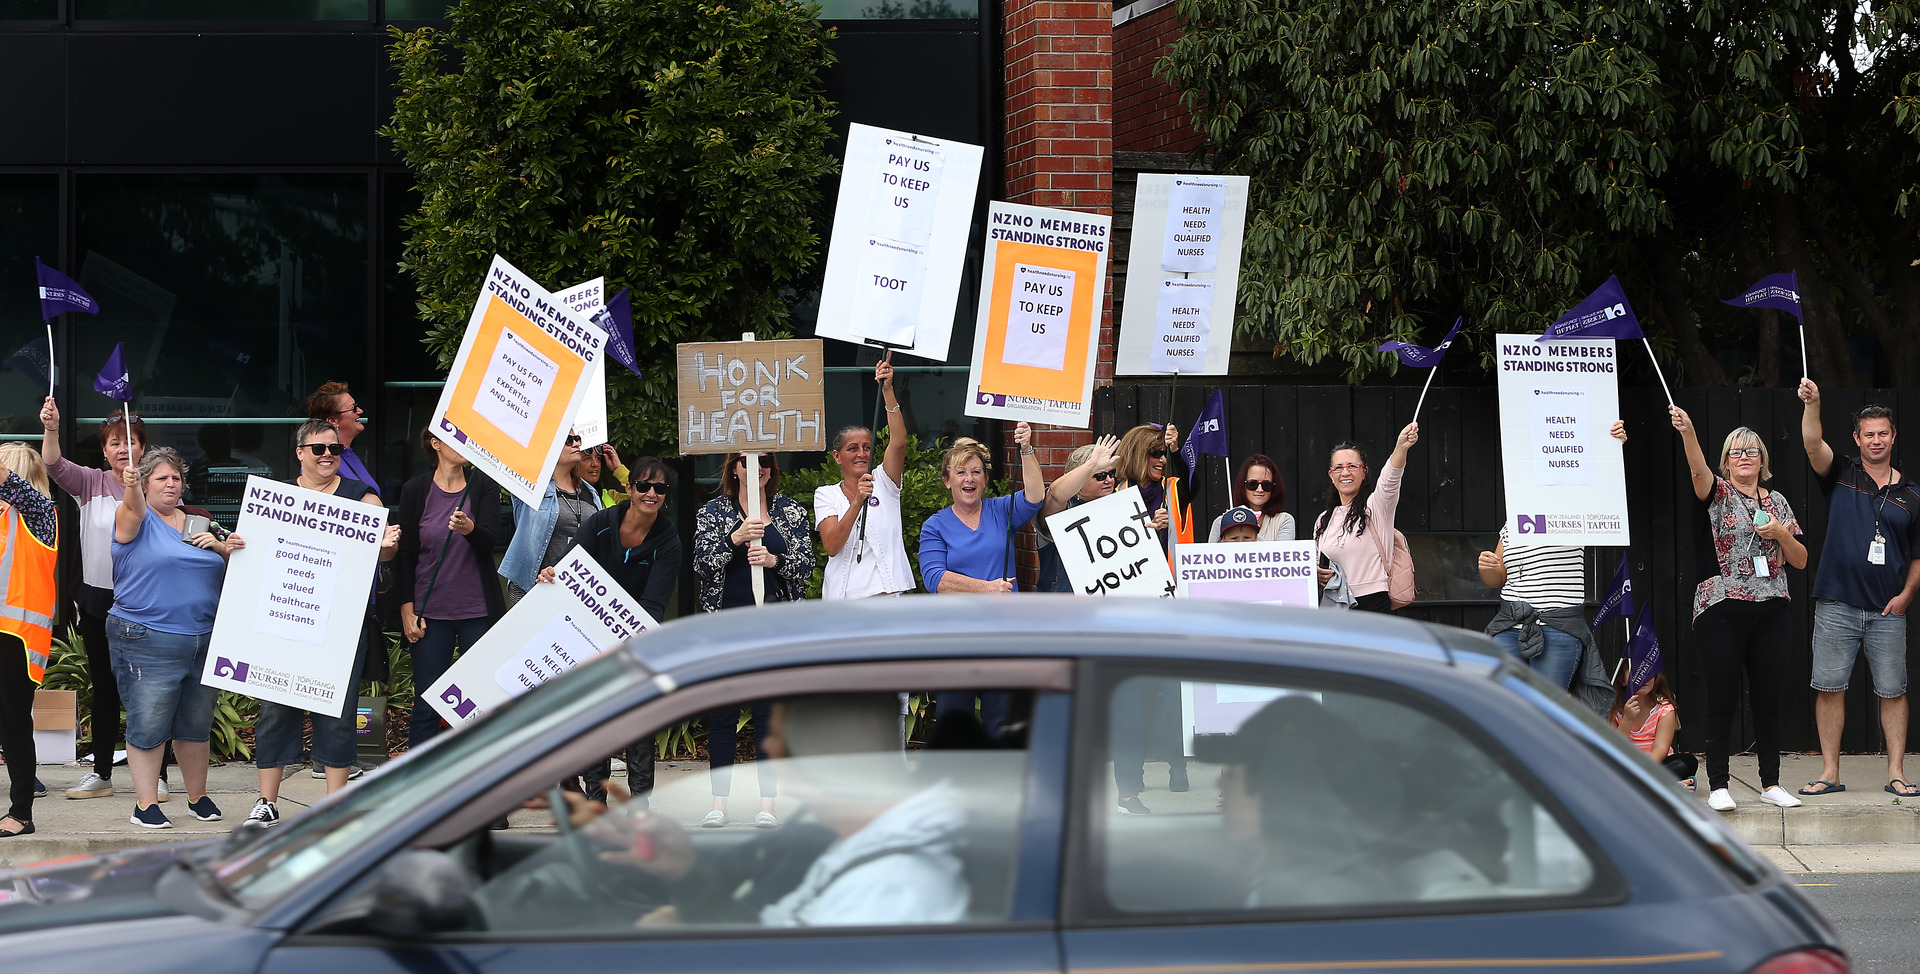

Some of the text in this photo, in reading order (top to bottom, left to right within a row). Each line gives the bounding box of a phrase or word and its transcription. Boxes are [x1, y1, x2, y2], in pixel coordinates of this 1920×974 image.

[889, 154, 930, 172] PAY US
[883, 173, 930, 191] TO KEEP
[894, 196, 909, 208] US
[1183, 206, 1210, 214] HEALTH
[993, 212, 1105, 236] NZNO MEMBERS
[991, 228, 1103, 252] STANDING STRONG
[1174, 234, 1211, 242] QUALIFIED
[1178, 248, 1204, 256] NURSES
[873, 275, 907, 291] TOOT
[1024, 281, 1063, 296] PAY US
[494, 267, 530, 299] NZNO
[535, 298, 599, 349] MEMBERS
[571, 298, 599, 314] ONG
[1019, 301, 1063, 317] TO KEEP
[1172, 307, 1200, 315] HEALTH
[488, 281, 546, 328] STANDING
[546, 323, 594, 362] STRONG
[1031, 323, 1046, 334] US
[1173, 321, 1195, 329] NEEDS
[1163, 335, 1200, 343] QUALIFIED
[1503, 345, 1613, 358] NZNO MEMBERS
[502, 353, 543, 386] PAY US FOR
[694, 351, 810, 392] HONK
[1504, 361, 1614, 373] STANDING STRONG
[510, 374, 526, 389] OUR
[496, 377, 532, 407] EXPERTISE
[721, 383, 782, 410] FOR
[490, 388, 529, 420] AND SKILLS
[1007, 395, 1043, 405] NURSES
[1007, 403, 1042, 411] ORGANISATION
[1048, 400, 1081, 410] TAPUHI
[687, 405, 820, 445] HEALTH
[1546, 416, 1576, 424] HEALTH
[1542, 446, 1584, 454] QUALIFIED
[1549, 460, 1579, 468] NURSES
[250, 487, 380, 528] NZNO MEMBERS
[246, 503, 376, 544] STANDING STRONG
[1547, 521, 1582, 529] NURSES
[1587, 521, 1621, 529] TAPUHI
[1064, 501, 1151, 564] Toot
[275, 549, 332, 568] good health
[1181, 550, 1311, 565] NZNO MEMBERS
[287, 567, 315, 580] needs
[570, 559, 607, 597] NZNO
[1085, 557, 1149, 596] your
[1182, 566, 1311, 580] STANDING STRONG
[282, 581, 314, 594] valued
[270, 593, 320, 611] healthcare
[558, 571, 633, 642] STANDING ST
[269, 609, 315, 626] assistants
[250, 671, 289, 687] NURSES
[265, 668, 290, 678] ZEALAND
[248, 680, 287, 693] ORGANISATION
[296, 683, 335, 699] TAPUHI
